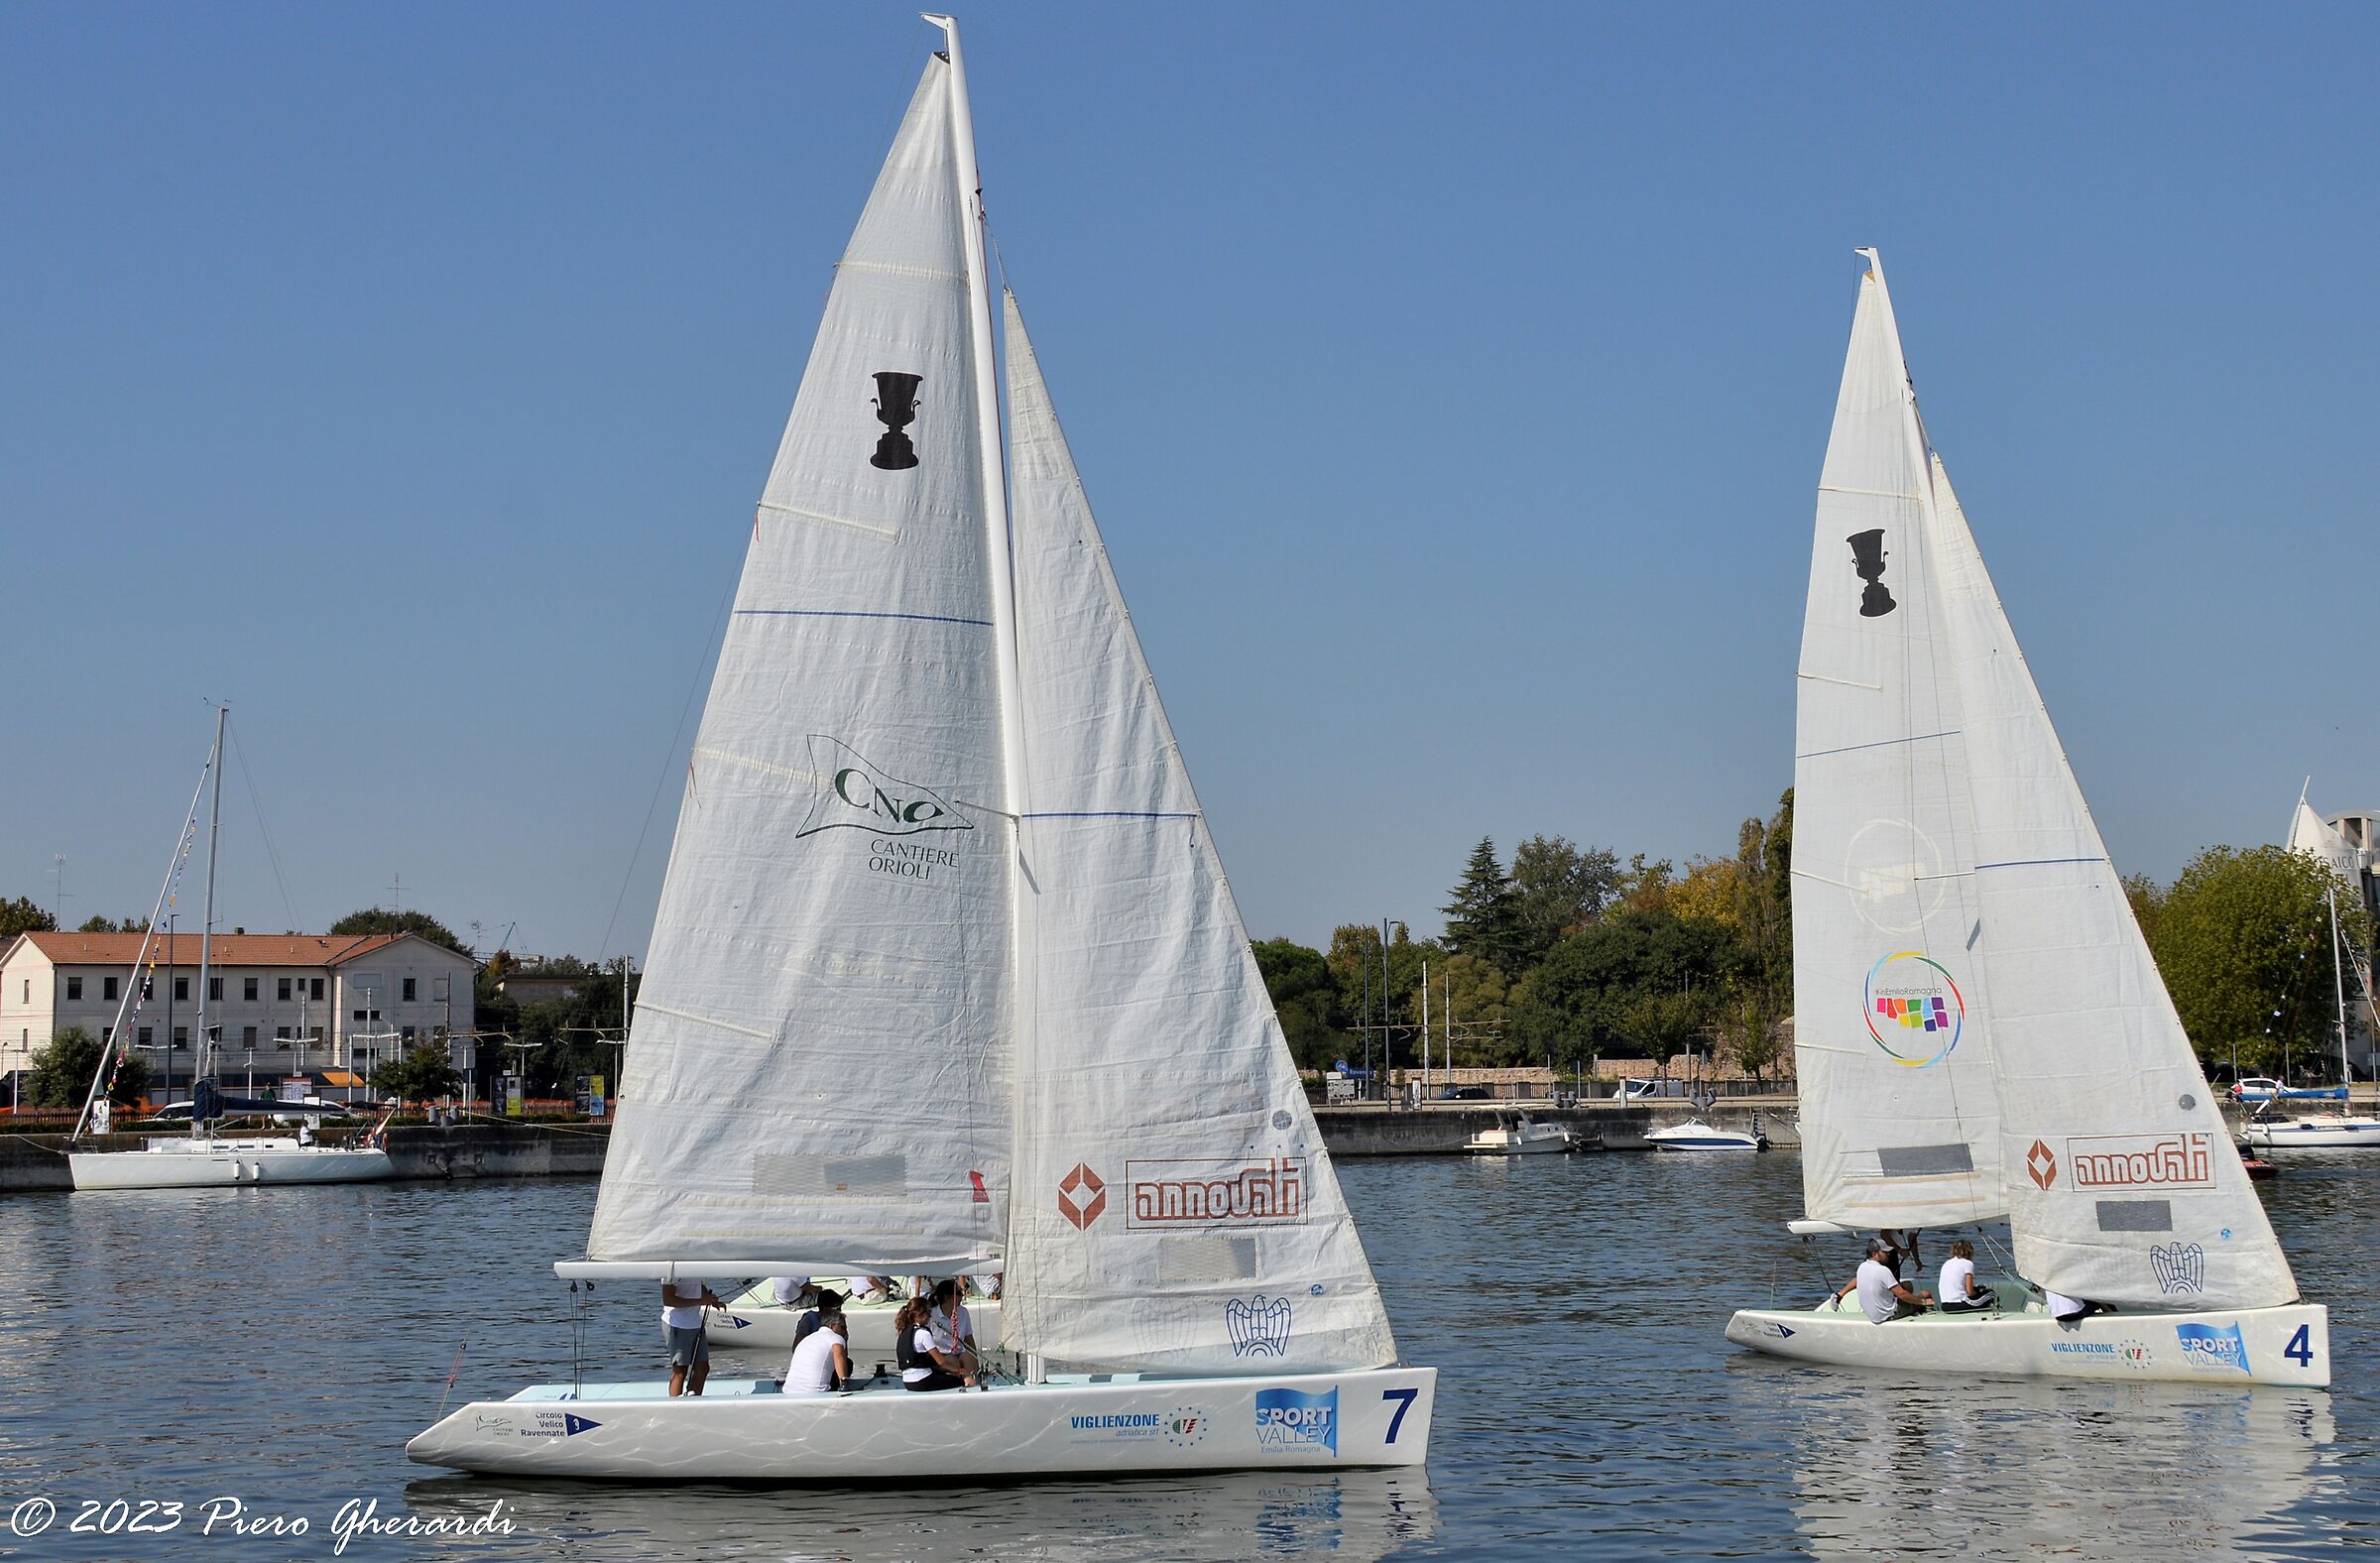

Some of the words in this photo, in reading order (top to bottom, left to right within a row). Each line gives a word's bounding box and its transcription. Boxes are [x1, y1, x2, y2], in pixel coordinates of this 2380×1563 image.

[871, 839, 960, 868] CANTIERE
[869, 856, 931, 881] ORIOLI
[2051, 1343, 2116, 1354] VIGLIENZONE
[2181, 1338, 2238, 1352] SPORT
[2284, 1324, 2314, 1368] 4
[2184, 1352, 2242, 1367] VALLEY
[1071, 1414, 1160, 1428] VIGLIENZONE
[1255, 1406, 1333, 1426] SPORT
[1382, 1388, 1418, 1444] 7
[1116, 1428, 1147, 1437] adriatica
[1255, 1426, 1331, 1444] VALLEY
[1260, 1445, 1321, 1454] Emilia-Romagna
